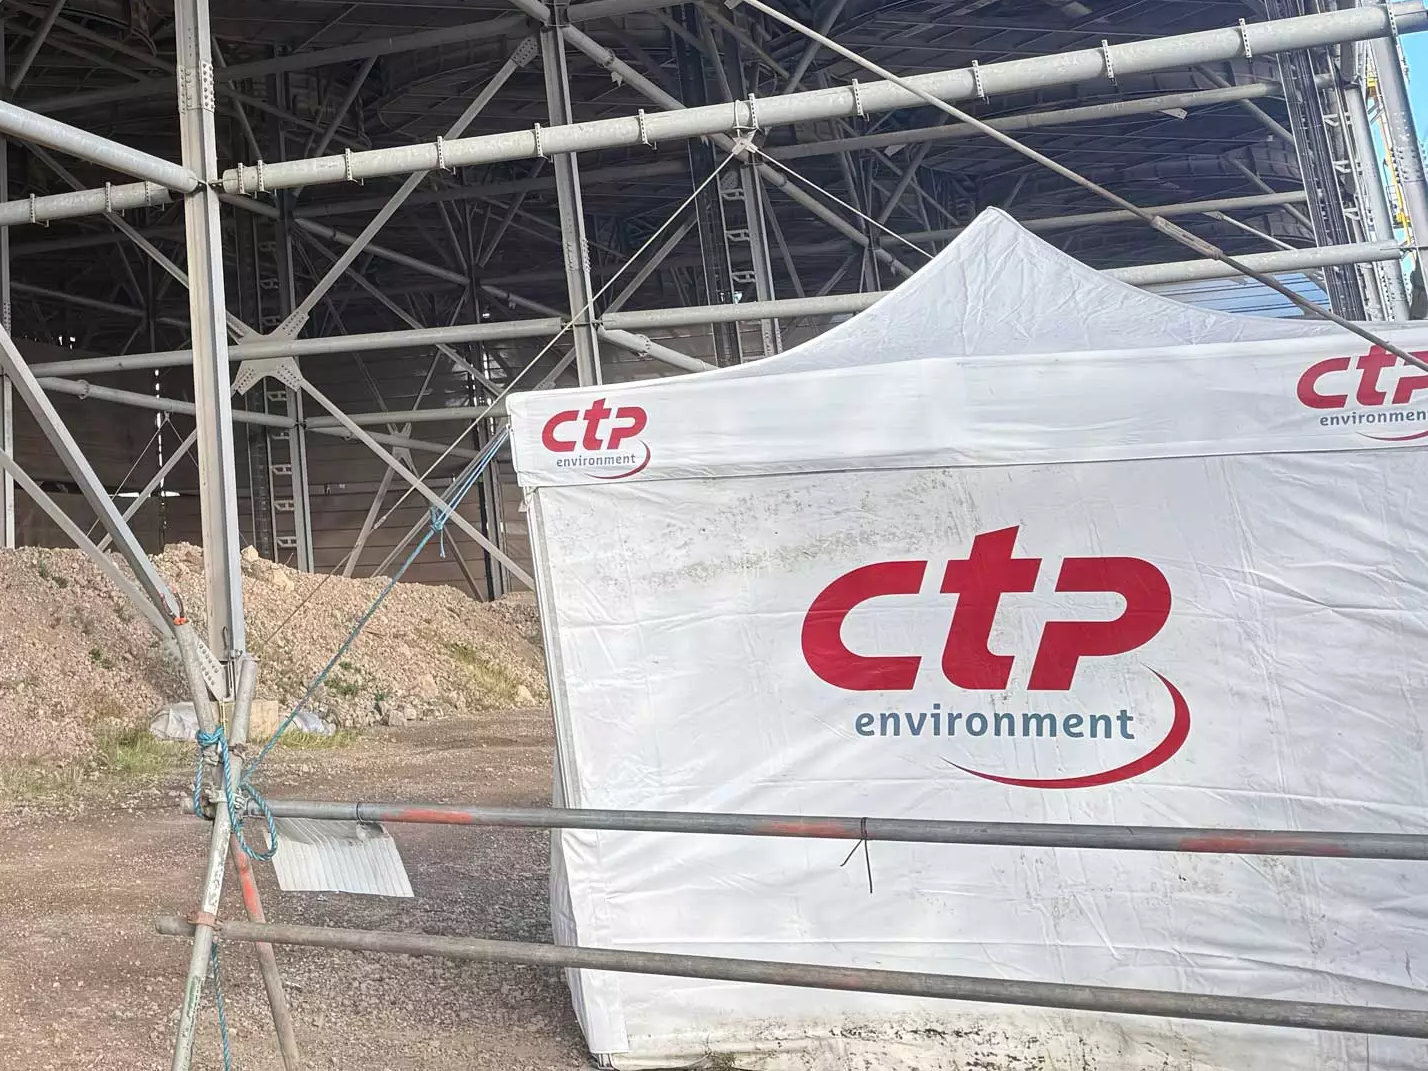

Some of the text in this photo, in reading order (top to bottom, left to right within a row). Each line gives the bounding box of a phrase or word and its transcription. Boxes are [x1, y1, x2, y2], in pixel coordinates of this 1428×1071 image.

[1319, 411, 1428, 426] environmen
[556, 454, 636, 468] environment
[855, 703, 1135, 740] environment
